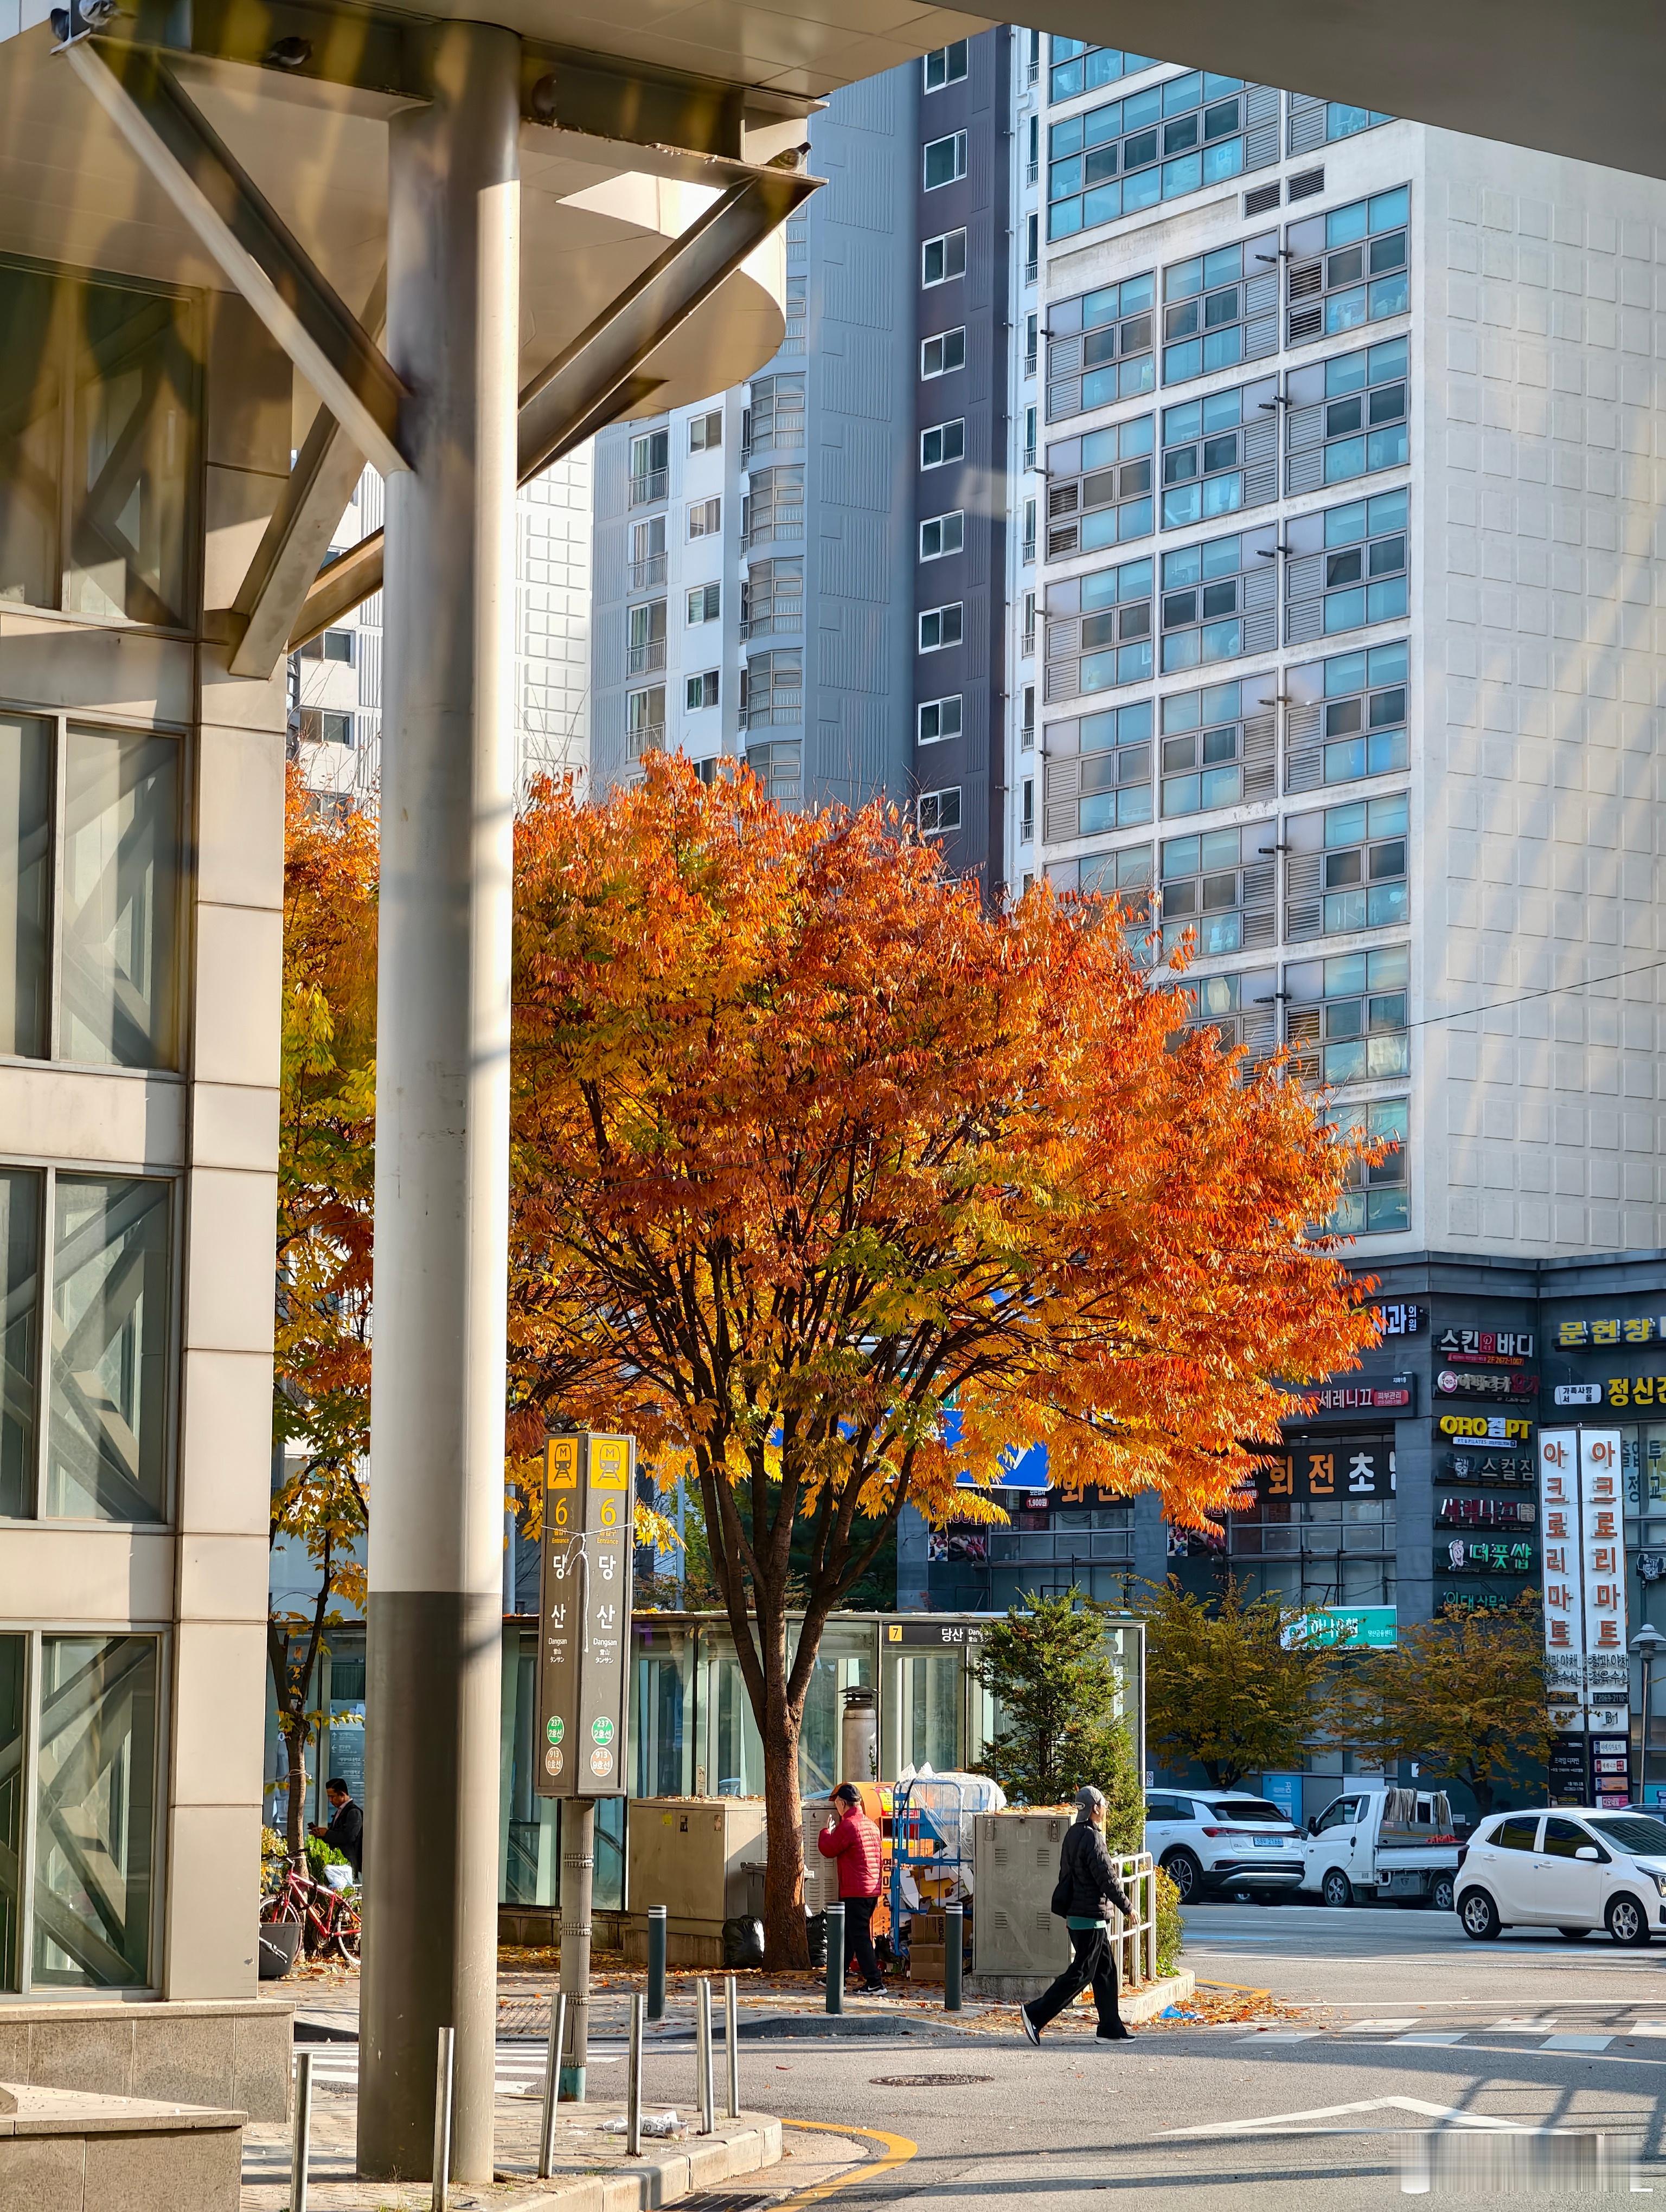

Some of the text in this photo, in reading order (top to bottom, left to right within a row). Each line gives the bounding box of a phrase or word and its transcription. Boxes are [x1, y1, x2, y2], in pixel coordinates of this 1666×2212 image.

[1440, 1329, 1534, 1358] 스킨 바디
[555, 1497, 568, 1525] 6
[601, 1497, 616, 1526] 6
[1544, 1441, 1569, 1646] 아크로리마트
[1592, 1441, 1621, 1645] 아크로리마트
[551, 1554, 567, 1629] 당산
[596, 1555, 617, 1630] 당산
[893, 1628, 899, 1639] 7
[941, 1628, 964, 1642] 당산
[968, 1628, 992, 1637] Dangan
[548, 1637, 568, 1646] Dangsan
[593, 1637, 617, 1647] Dangsan
[548, 1729, 562, 1738] 2호선
[594, 1729, 611, 1739] 2호선
[595, 1751, 608, 1759] 913
[548, 1760, 561, 1770] 9호선
[593, 1760, 610, 1770] 9호선
